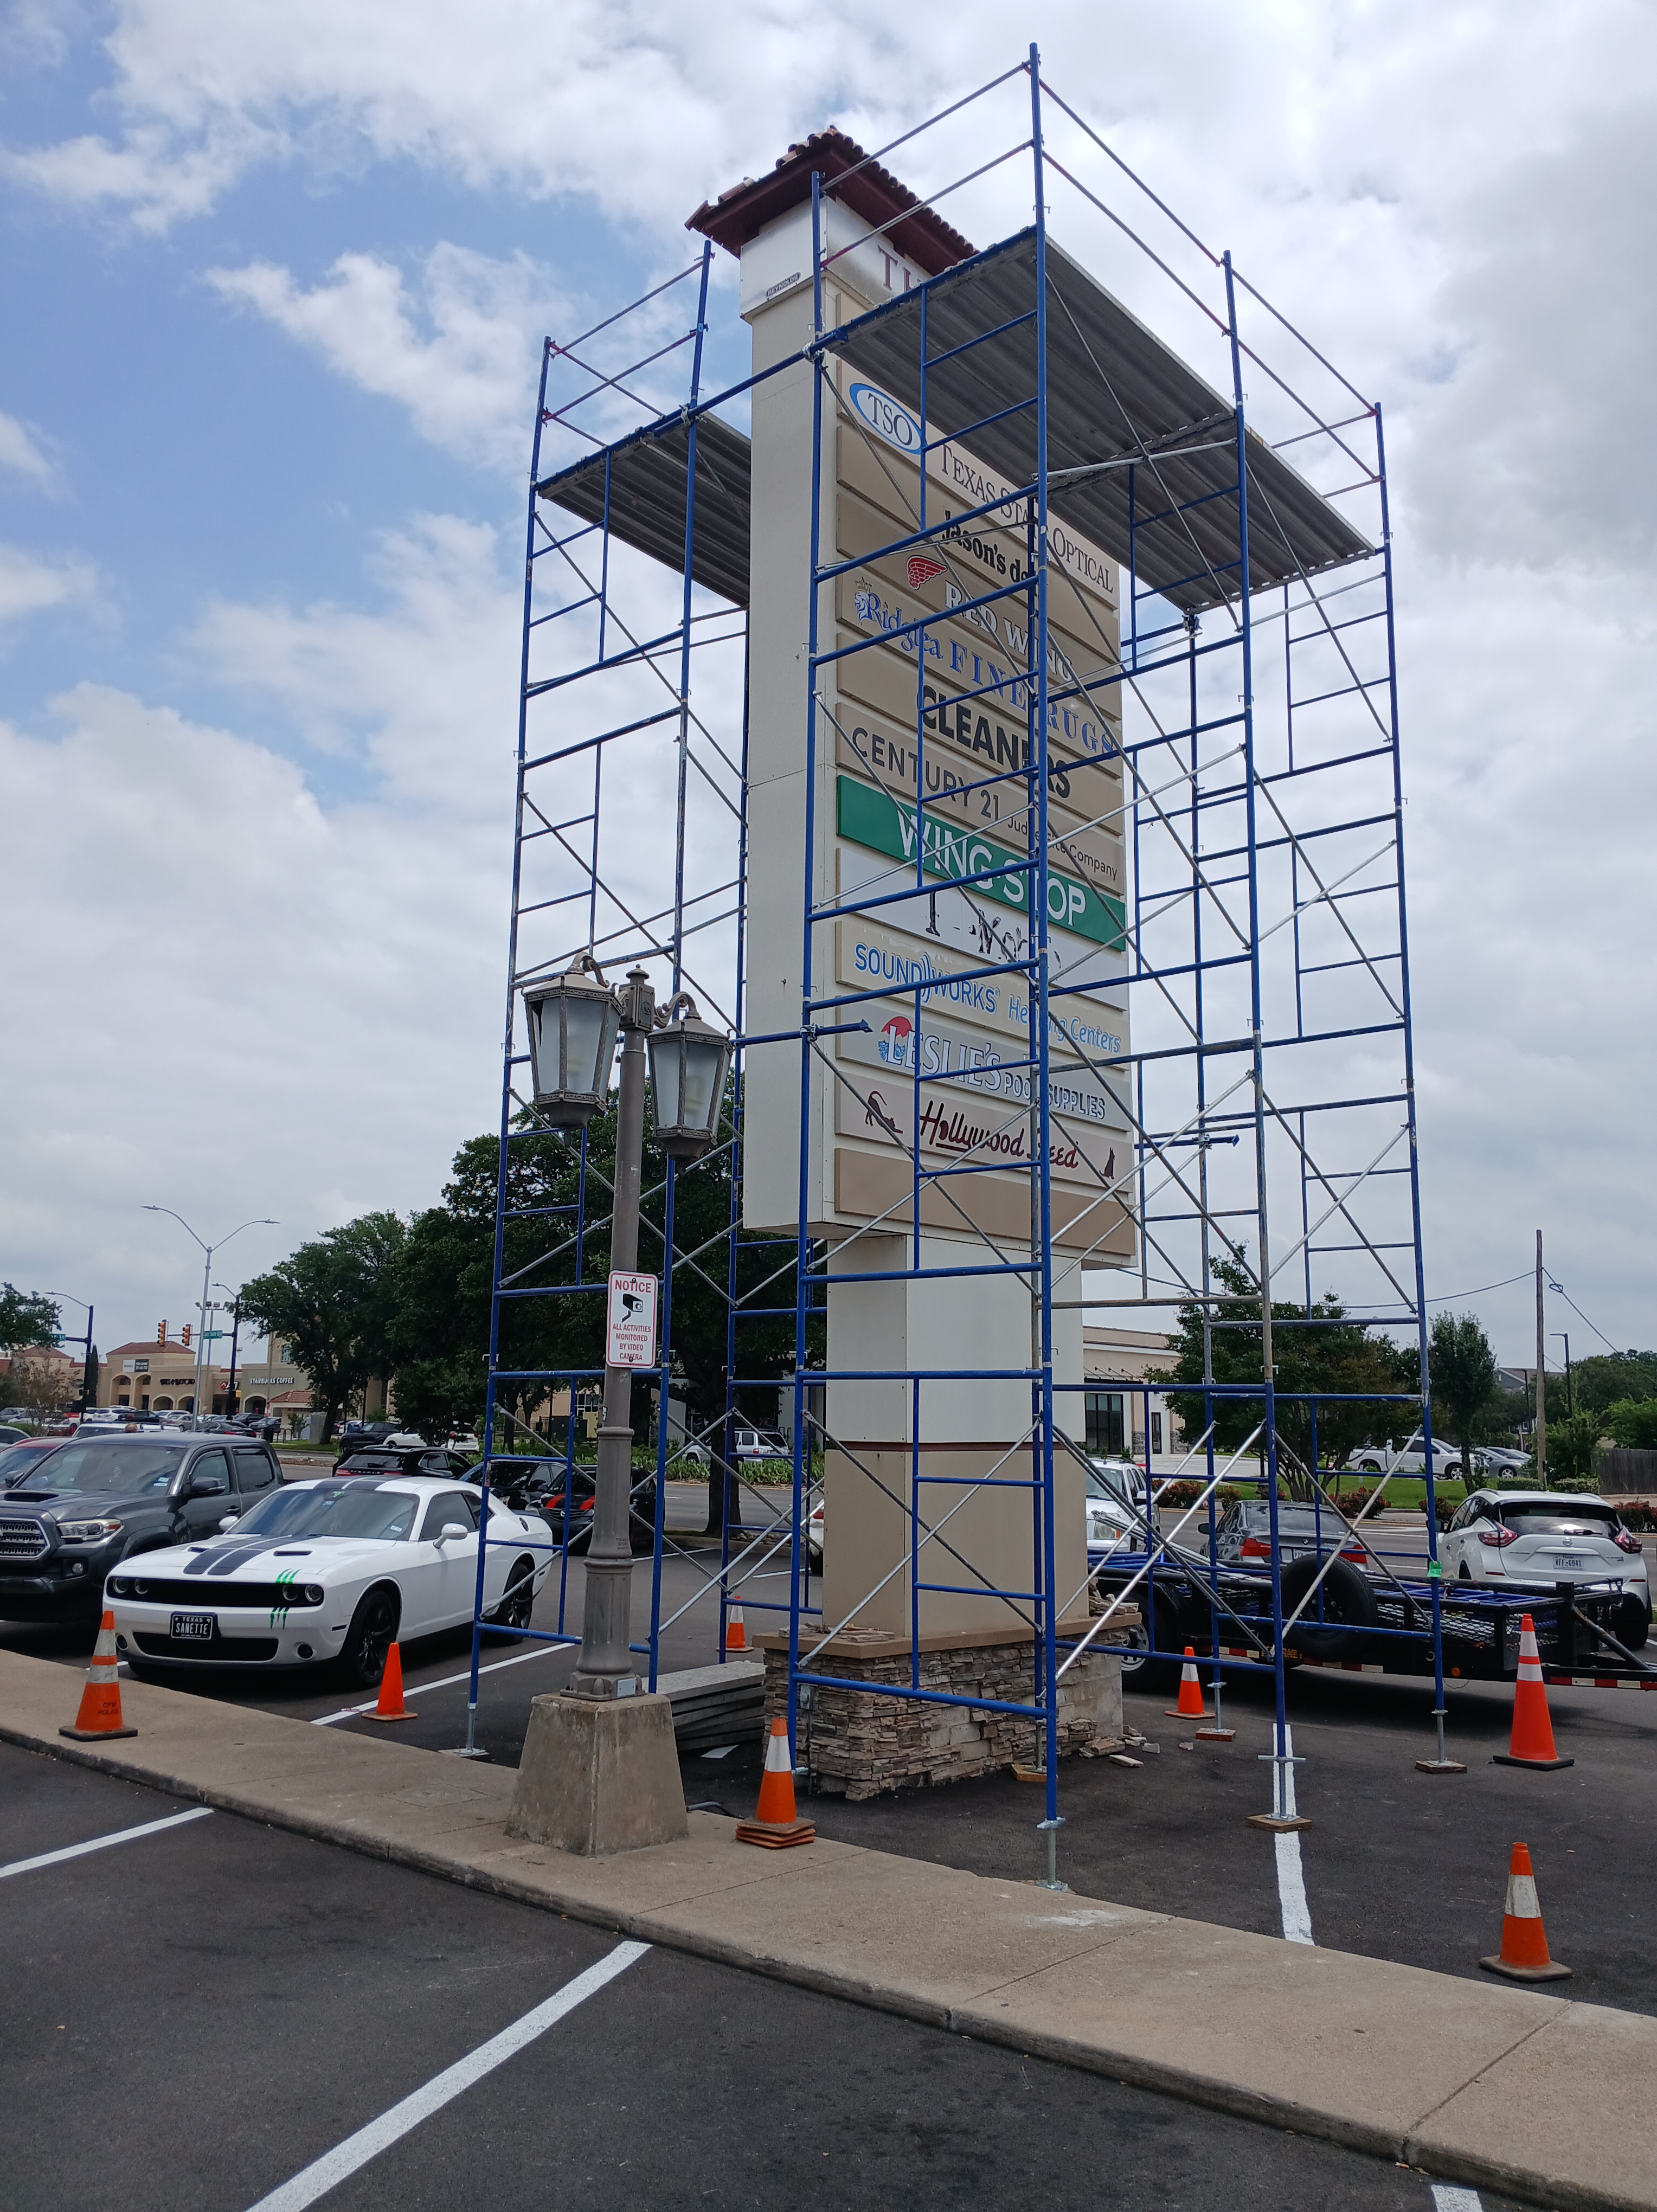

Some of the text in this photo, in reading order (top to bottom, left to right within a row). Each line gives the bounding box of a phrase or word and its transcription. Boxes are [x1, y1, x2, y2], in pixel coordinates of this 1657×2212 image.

[868, 392, 913, 446] TSO
[938, 442, 999, 505] TEXAS
[1052, 527, 1114, 594] OPTICAL
[945, 579, 998, 634] RED
[949, 638, 1026, 712] FINE
[852, 727, 999, 822] CENTURY 21
[1007, 816, 1039, 842] Jude
[1069, 844, 1117, 881] Company
[886, 1024, 1007, 1091] LESLIE'S
[1004, 1071, 1032, 1101] POO
[1070, 1018, 1120, 1053] Centers
[919, 1099, 1025, 1156] Hollywood
[615, 1279, 652, 1294] NOTICE
[615, 1333, 648, 1341] MONITORED
[623, 1324, 652, 1333] ACTIVITIES
[175, 1622, 208, 1635] SANETTE
